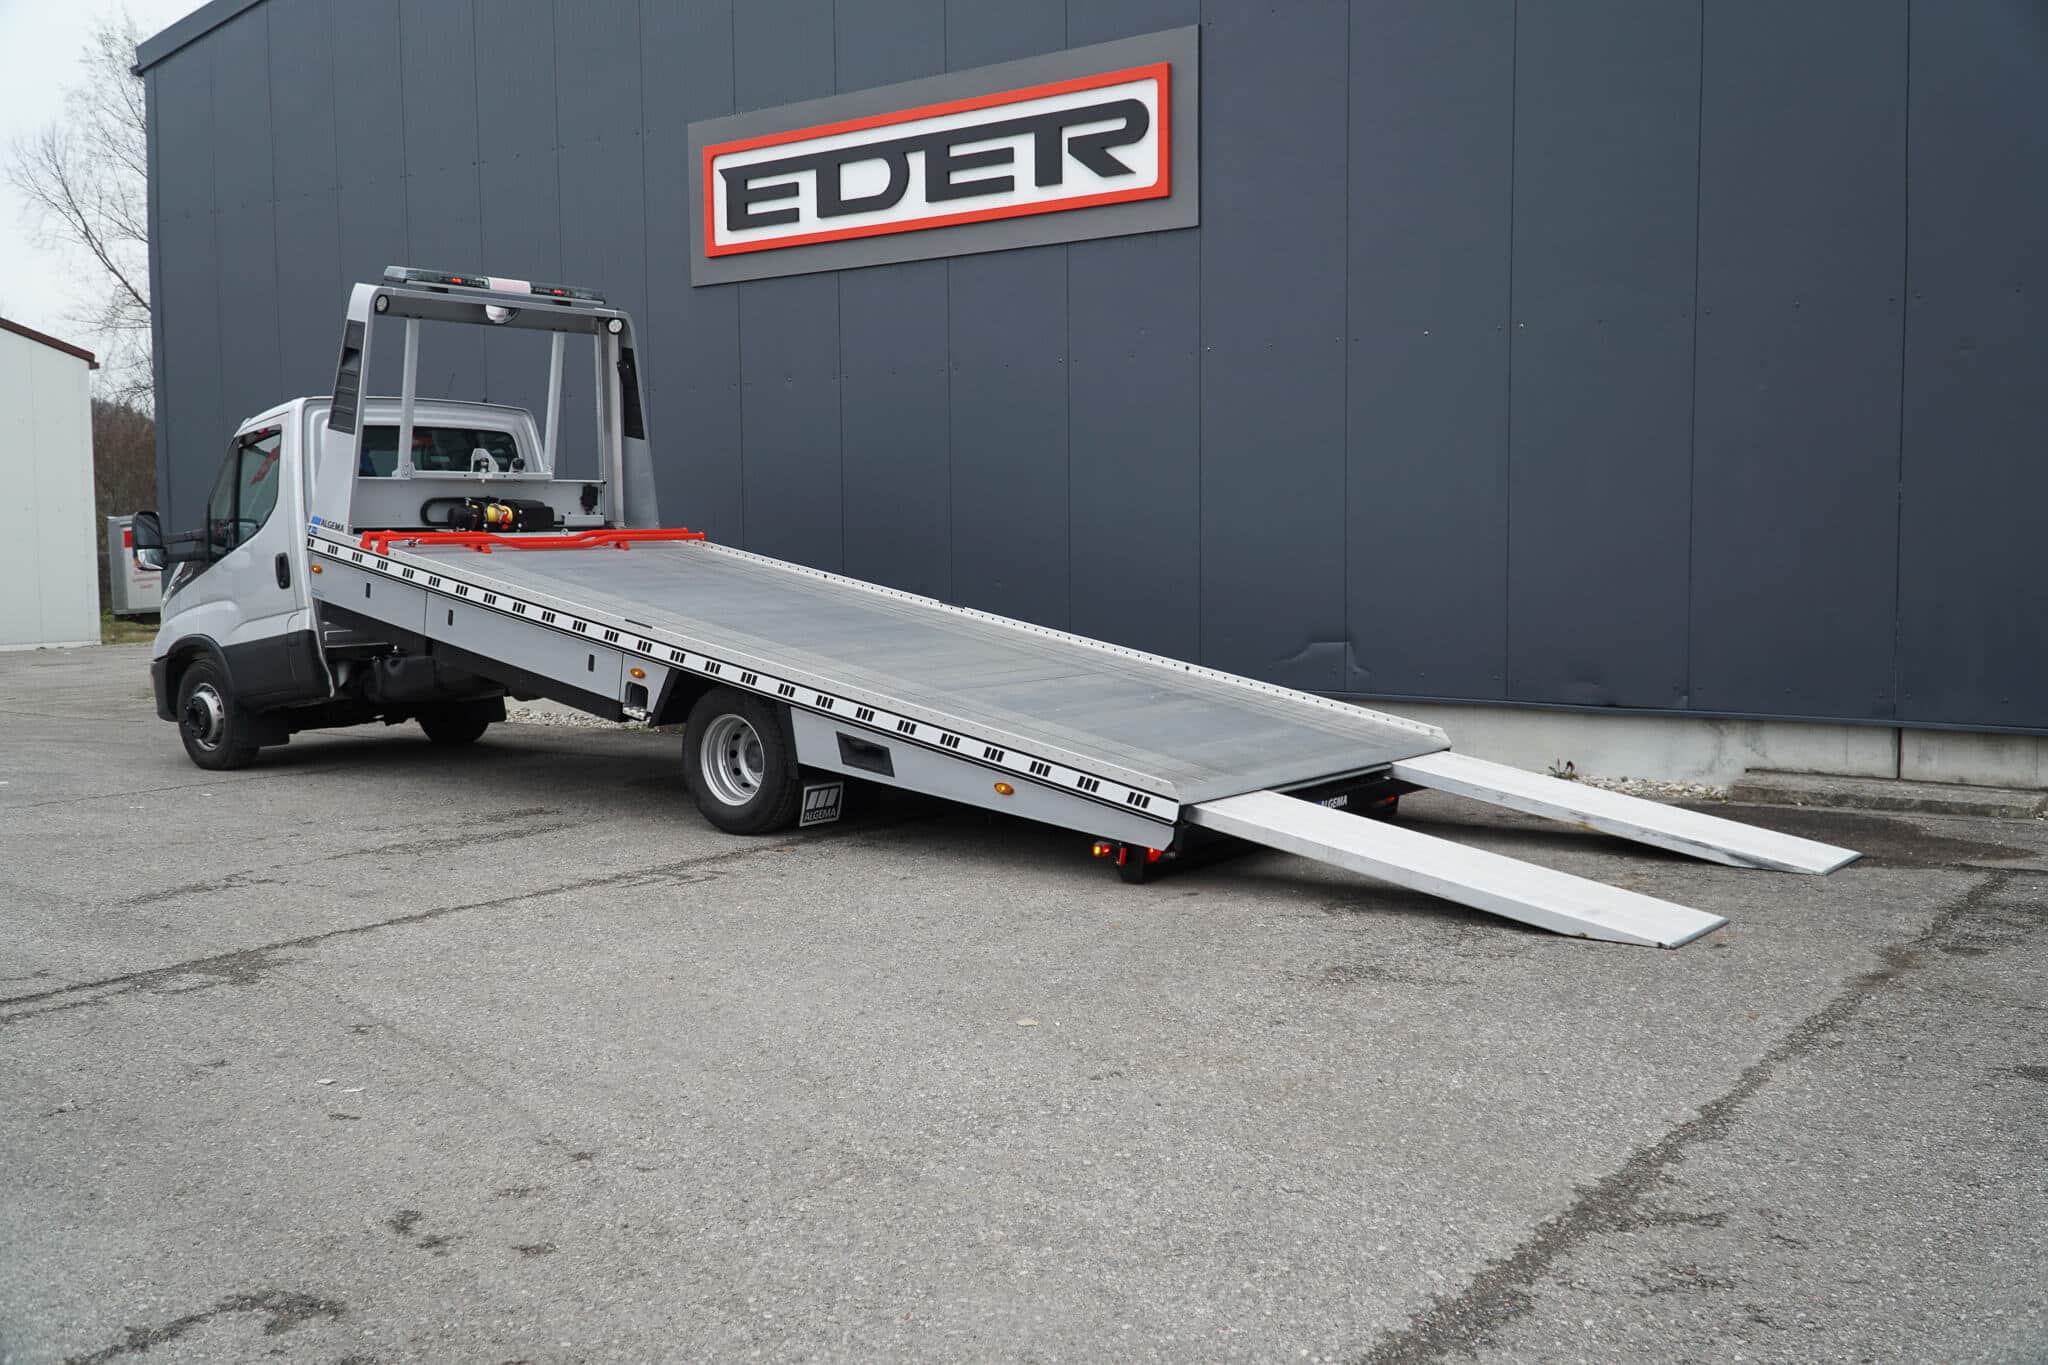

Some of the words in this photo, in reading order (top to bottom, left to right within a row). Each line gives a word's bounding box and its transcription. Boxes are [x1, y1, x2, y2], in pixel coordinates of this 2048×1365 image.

[718, 98, 1150, 231] EDER
[320, 519, 345, 532] ALGEMA
[1321, 794, 1348, 809] ALGEMA
[804, 807, 836, 821] ALGEMA
